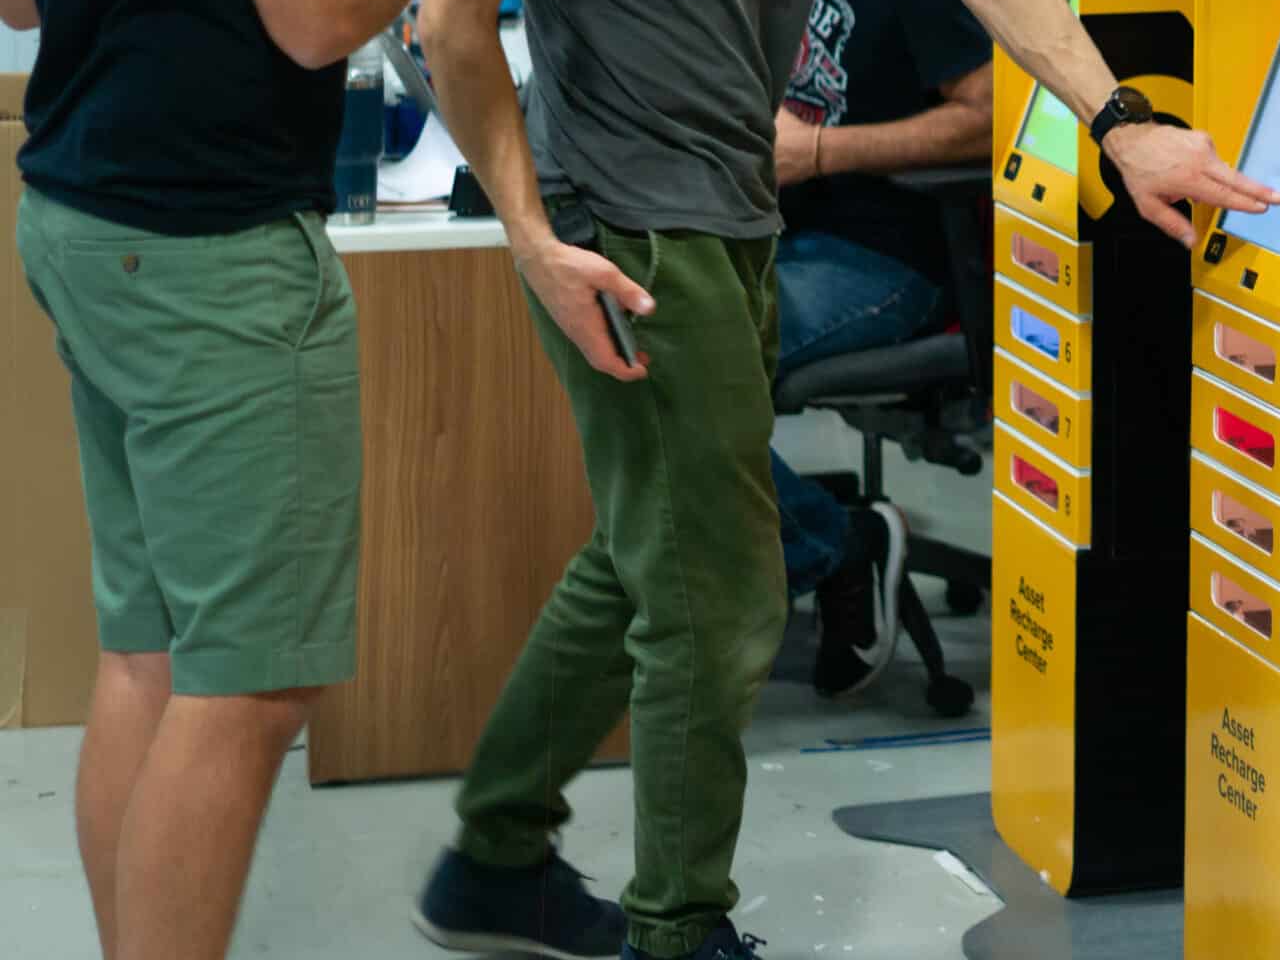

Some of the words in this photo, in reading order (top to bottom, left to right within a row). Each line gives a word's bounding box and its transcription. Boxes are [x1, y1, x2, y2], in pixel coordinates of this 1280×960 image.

[1222, 707, 1255, 751] Asset
[1210, 732, 1266, 793] Recharge
[1217, 773, 1258, 822] Center
